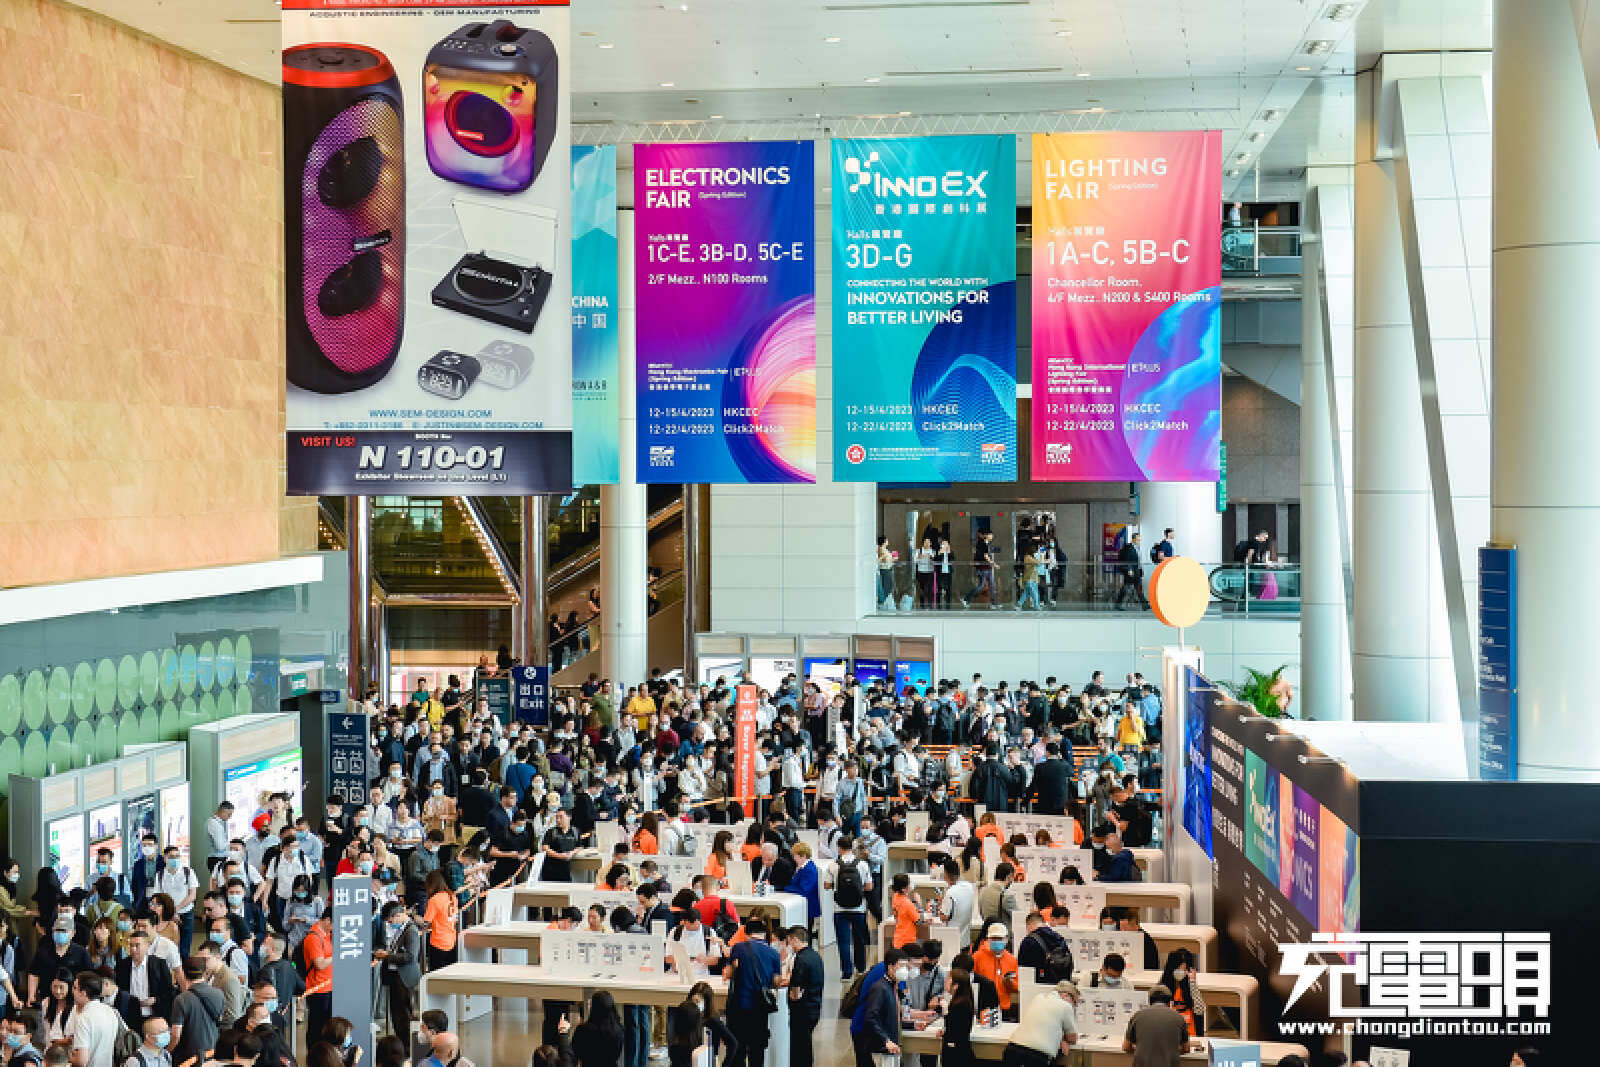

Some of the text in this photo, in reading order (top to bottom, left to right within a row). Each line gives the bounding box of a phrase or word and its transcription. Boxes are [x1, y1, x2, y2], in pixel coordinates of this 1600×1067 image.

[1045, 158, 1168, 177] LIGHTING
[645, 167, 791, 187] ELECTRONICS
[1045, 181, 1100, 200] FAIR
[645, 190, 691, 208] FAIR
[758, 241, 804, 262] 5C-E
[846, 243, 913, 269] 3D-G
[1047, 239, 1190, 266] 1A-C, 5B-C
[647, 273, 665, 285] 2/F
[731, 273, 769, 285] Rooms
[846, 276, 989, 288] CONNECTING THE WORLD WITH
[1047, 276, 1105, 288] Chancellor
[571, 295, 609, 307] CHINA
[847, 289, 990, 306] INNOVATIONS FOR
[1047, 291, 1065, 303] 4/F
[1173, 290, 1211, 303] Rooms
[847, 308, 963, 325] BETTER LIVING
[649, 407, 759, 418] 12-15/4/2023 HKCEC
[846, 403, 959, 415] 12-15/4/2023 HKCEC
[1046, 403, 1161, 414] 12-15/4/2023 HKCEC
[649, 423, 785, 435] 12-22/4/2023 Click2Match
[846, 420, 985, 432] 12-22/4/2023 Click2Match
[1046, 419, 1189, 431] 12-22/4/2023 Click2Match
[301, 435, 356, 447] VISIT US!
[360, 445, 505, 470] N 110-01
[339, 913, 365, 960] Exit
